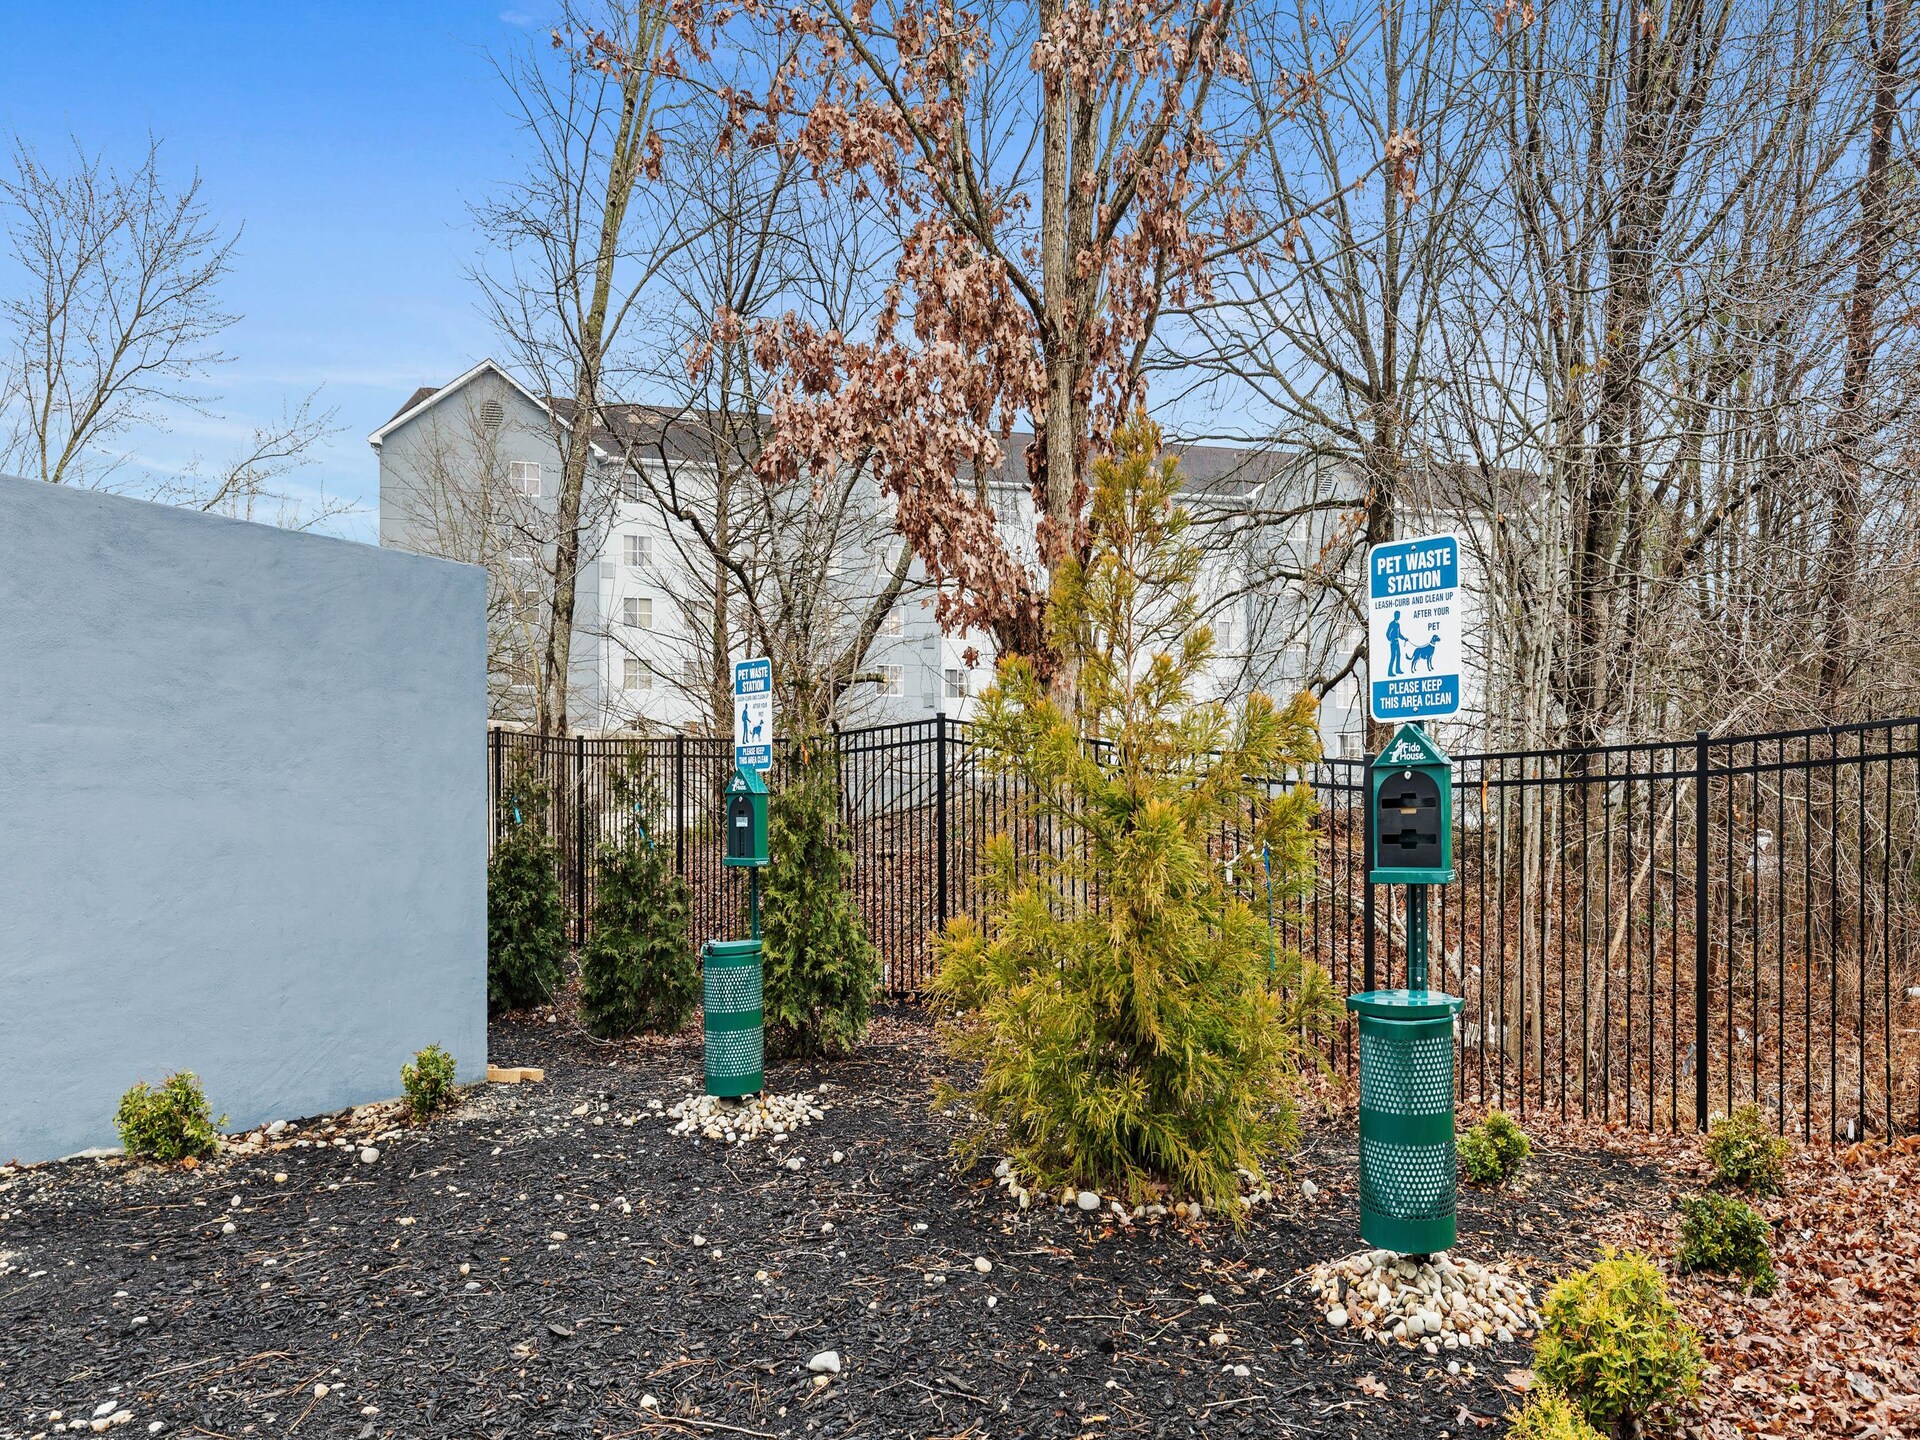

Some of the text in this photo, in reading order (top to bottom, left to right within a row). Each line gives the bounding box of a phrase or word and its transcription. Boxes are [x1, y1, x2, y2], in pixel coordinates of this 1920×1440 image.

[1377, 547, 1451, 576] PET WASTE
[1387, 569, 1441, 594] STATION
[1375, 591, 1454, 610] LEASH-CURB AND CLEAN UP
[1413, 606, 1450, 619] AFTER YOUR
[1427, 621, 1440, 631] PET
[738, 666, 768, 681] PET WASTE
[742, 679, 764, 693] STATION
[1388, 678, 1443, 695] PLEASE KEEP
[1380, 692, 1452, 710] THIS AREA CLEAN
[742, 747, 756, 756] PLEASE
[1402, 742, 1421, 752] Fido
